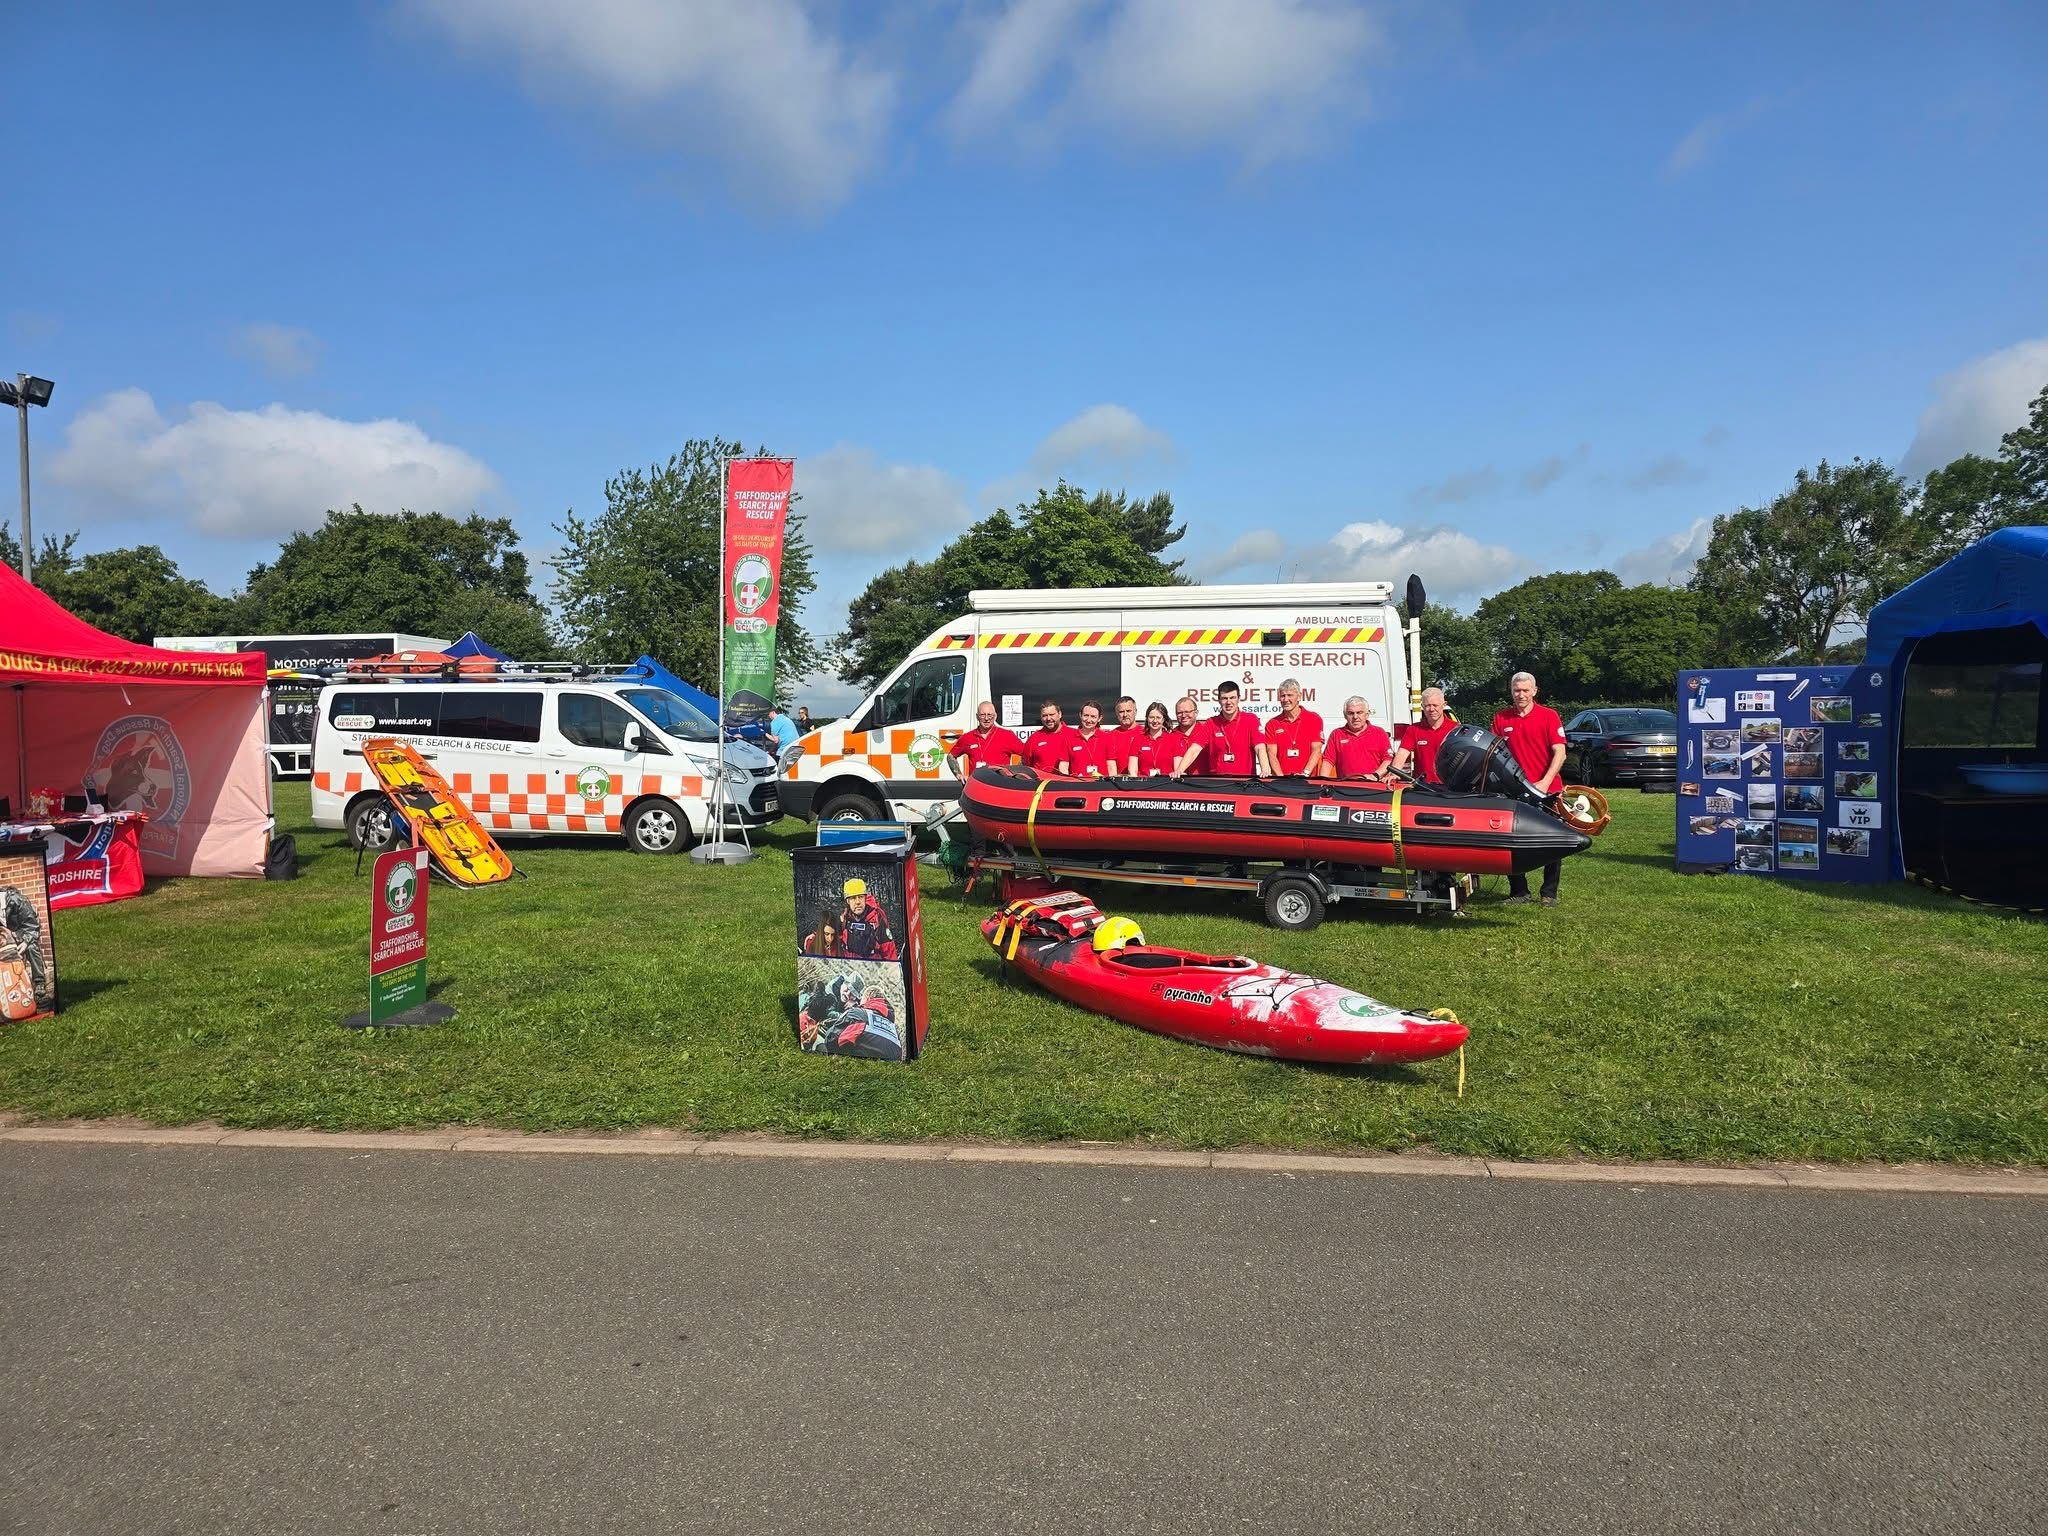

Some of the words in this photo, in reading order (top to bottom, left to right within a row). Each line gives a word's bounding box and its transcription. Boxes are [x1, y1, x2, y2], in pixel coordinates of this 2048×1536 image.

[739, 501, 767, 510] SEARCH
[745, 510, 775, 520] RESCUE
[1294, 615, 1363, 625] AMBULANCE
[47, 656, 58, 673] A
[190, 662, 214, 677] THE
[214, 662, 245, 678] YEAR
[1135, 653, 1284, 668] STAFFORDSHIRE
[1289, 652, 1366, 667] SEARCH
[1242, 670, 1255, 684] &
[1187, 688, 1261, 702] RESUE
[1265, 688, 1316, 702] TM
[378, 717, 432, 727] www.ssart.org
[426, 738, 464, 749] SEARCH
[464, 741, 471, 749] &
[473, 741, 513, 752] RESCUE
[1115, 800, 1171, 810] STAFFORDSHIRE
[1171, 801, 1199, 811] SEARCH
[1199, 802, 1206, 812] &
[1206, 803, 1235, 813] RESCUE
[1849, 815, 1871, 825] VIP
[48, 869, 103, 885] RDSHIRE
[380, 930, 419, 950] STAFFORDSHIRE
[373, 949, 394, 963] SEARCH
[394, 944, 406, 955] AND
[406, 938, 425, 950] RESCUE
[1163, 988, 1213, 1004] pyranha
